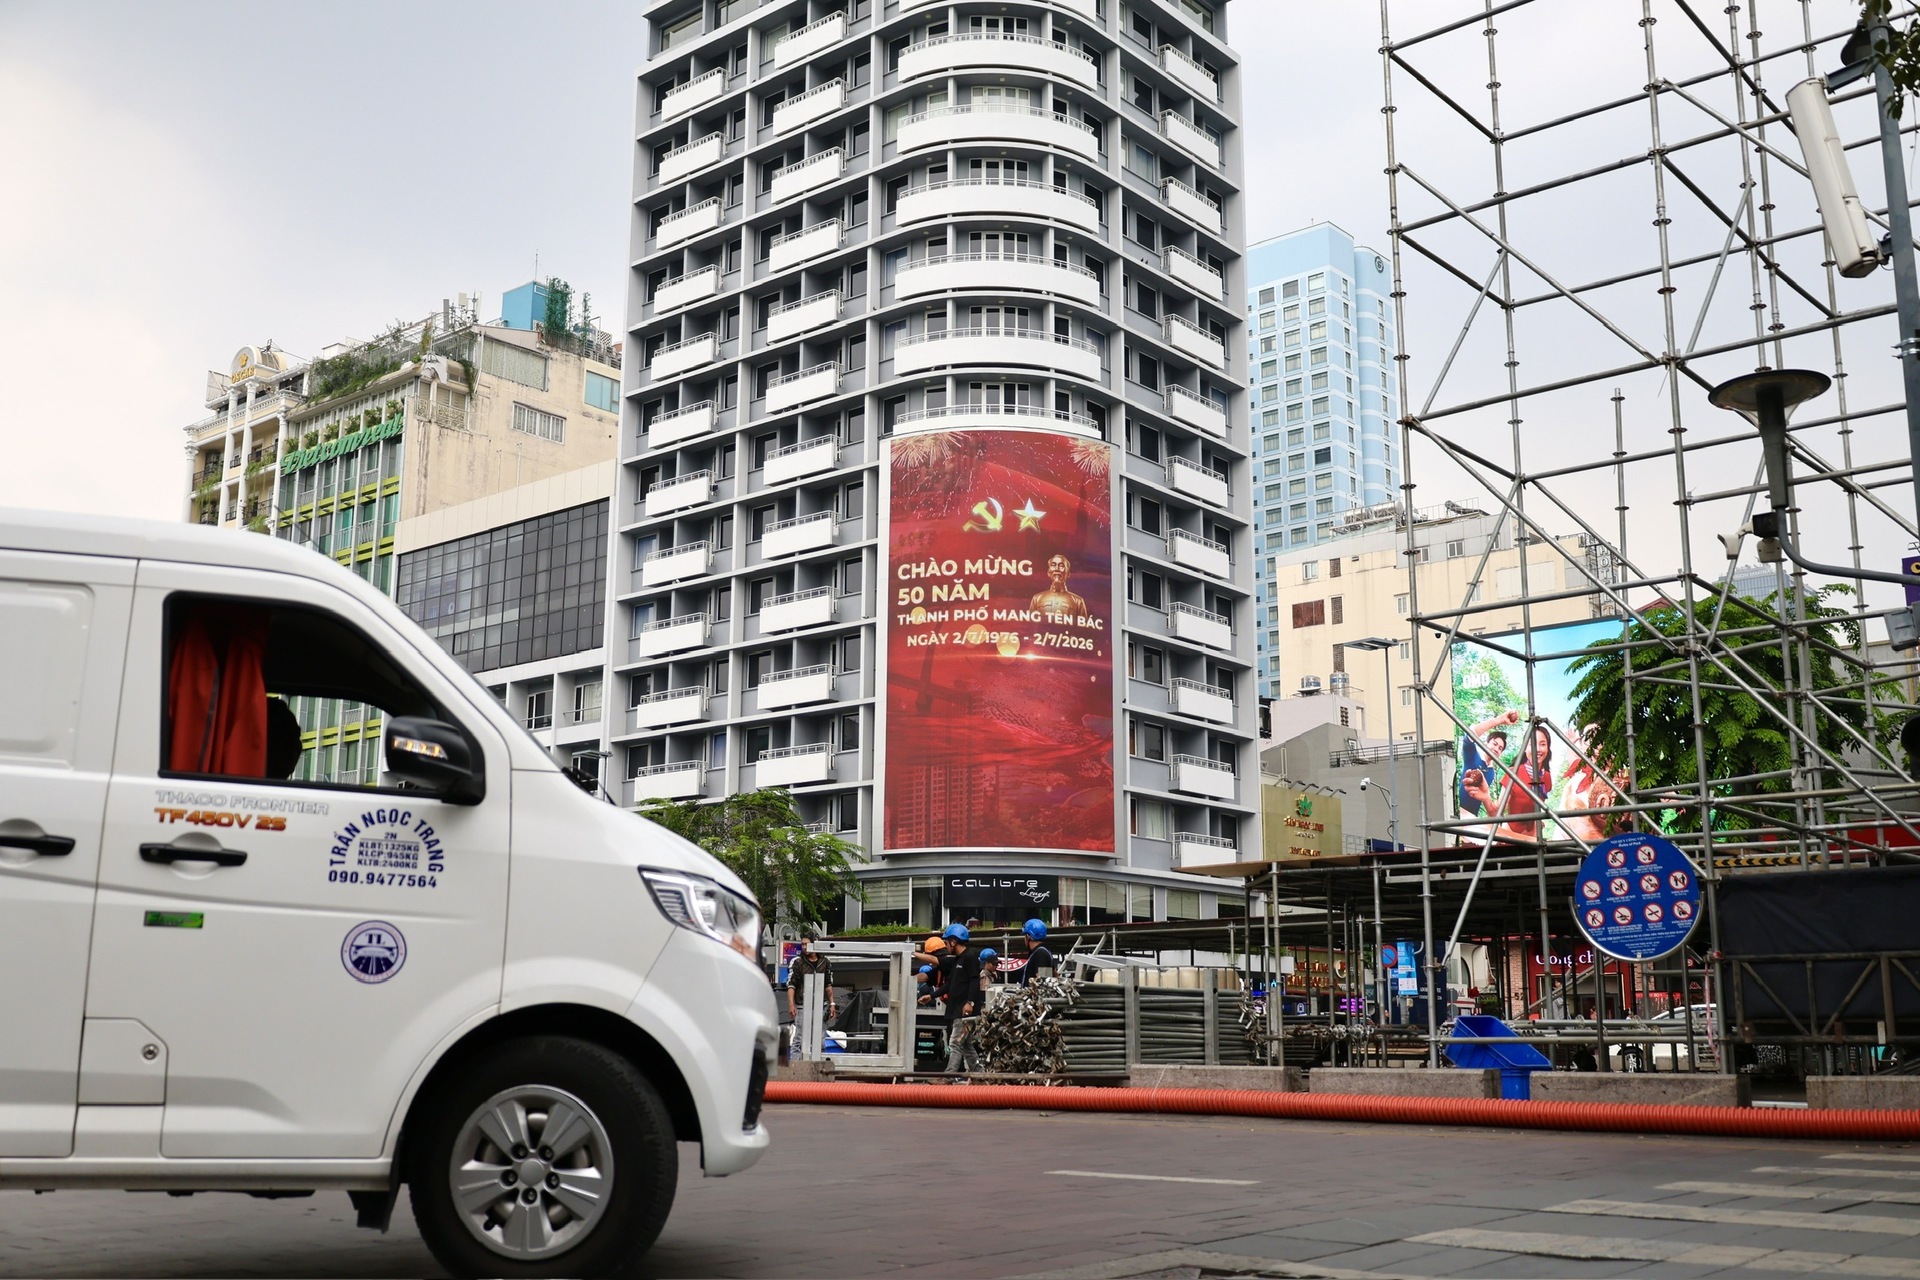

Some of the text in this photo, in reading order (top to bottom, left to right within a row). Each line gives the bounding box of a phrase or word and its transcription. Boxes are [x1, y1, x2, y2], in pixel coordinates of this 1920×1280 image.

[231, 365, 255, 385] OSCAR
[897, 554, 1034, 580] CHÀO MỪNG
[897, 578, 990, 606] 50 NĂM
[953, 604, 989, 622] PHỐ
[993, 608, 1042, 623] MANG
[1045, 609, 1074, 626] TÊN
[1077, 613, 1104, 631] BÁC
[906, 630, 949, 647] NGÀY
[952, 631, 1020, 646] 2/7/1976
[1033, 632, 1094, 651] 2/7/2026
[1462, 671, 1490, 690] OMO
[154, 789, 330, 815] THACO FRONTIER
[153, 807, 252, 829] TF450V
[361, 808, 412, 829] NGỌC
[413, 819, 445, 873] TRANG
[384, 831, 398, 841] 2N
[328, 870, 437, 888] 090.9477564
[1579, 950, 1599, 965] ch
